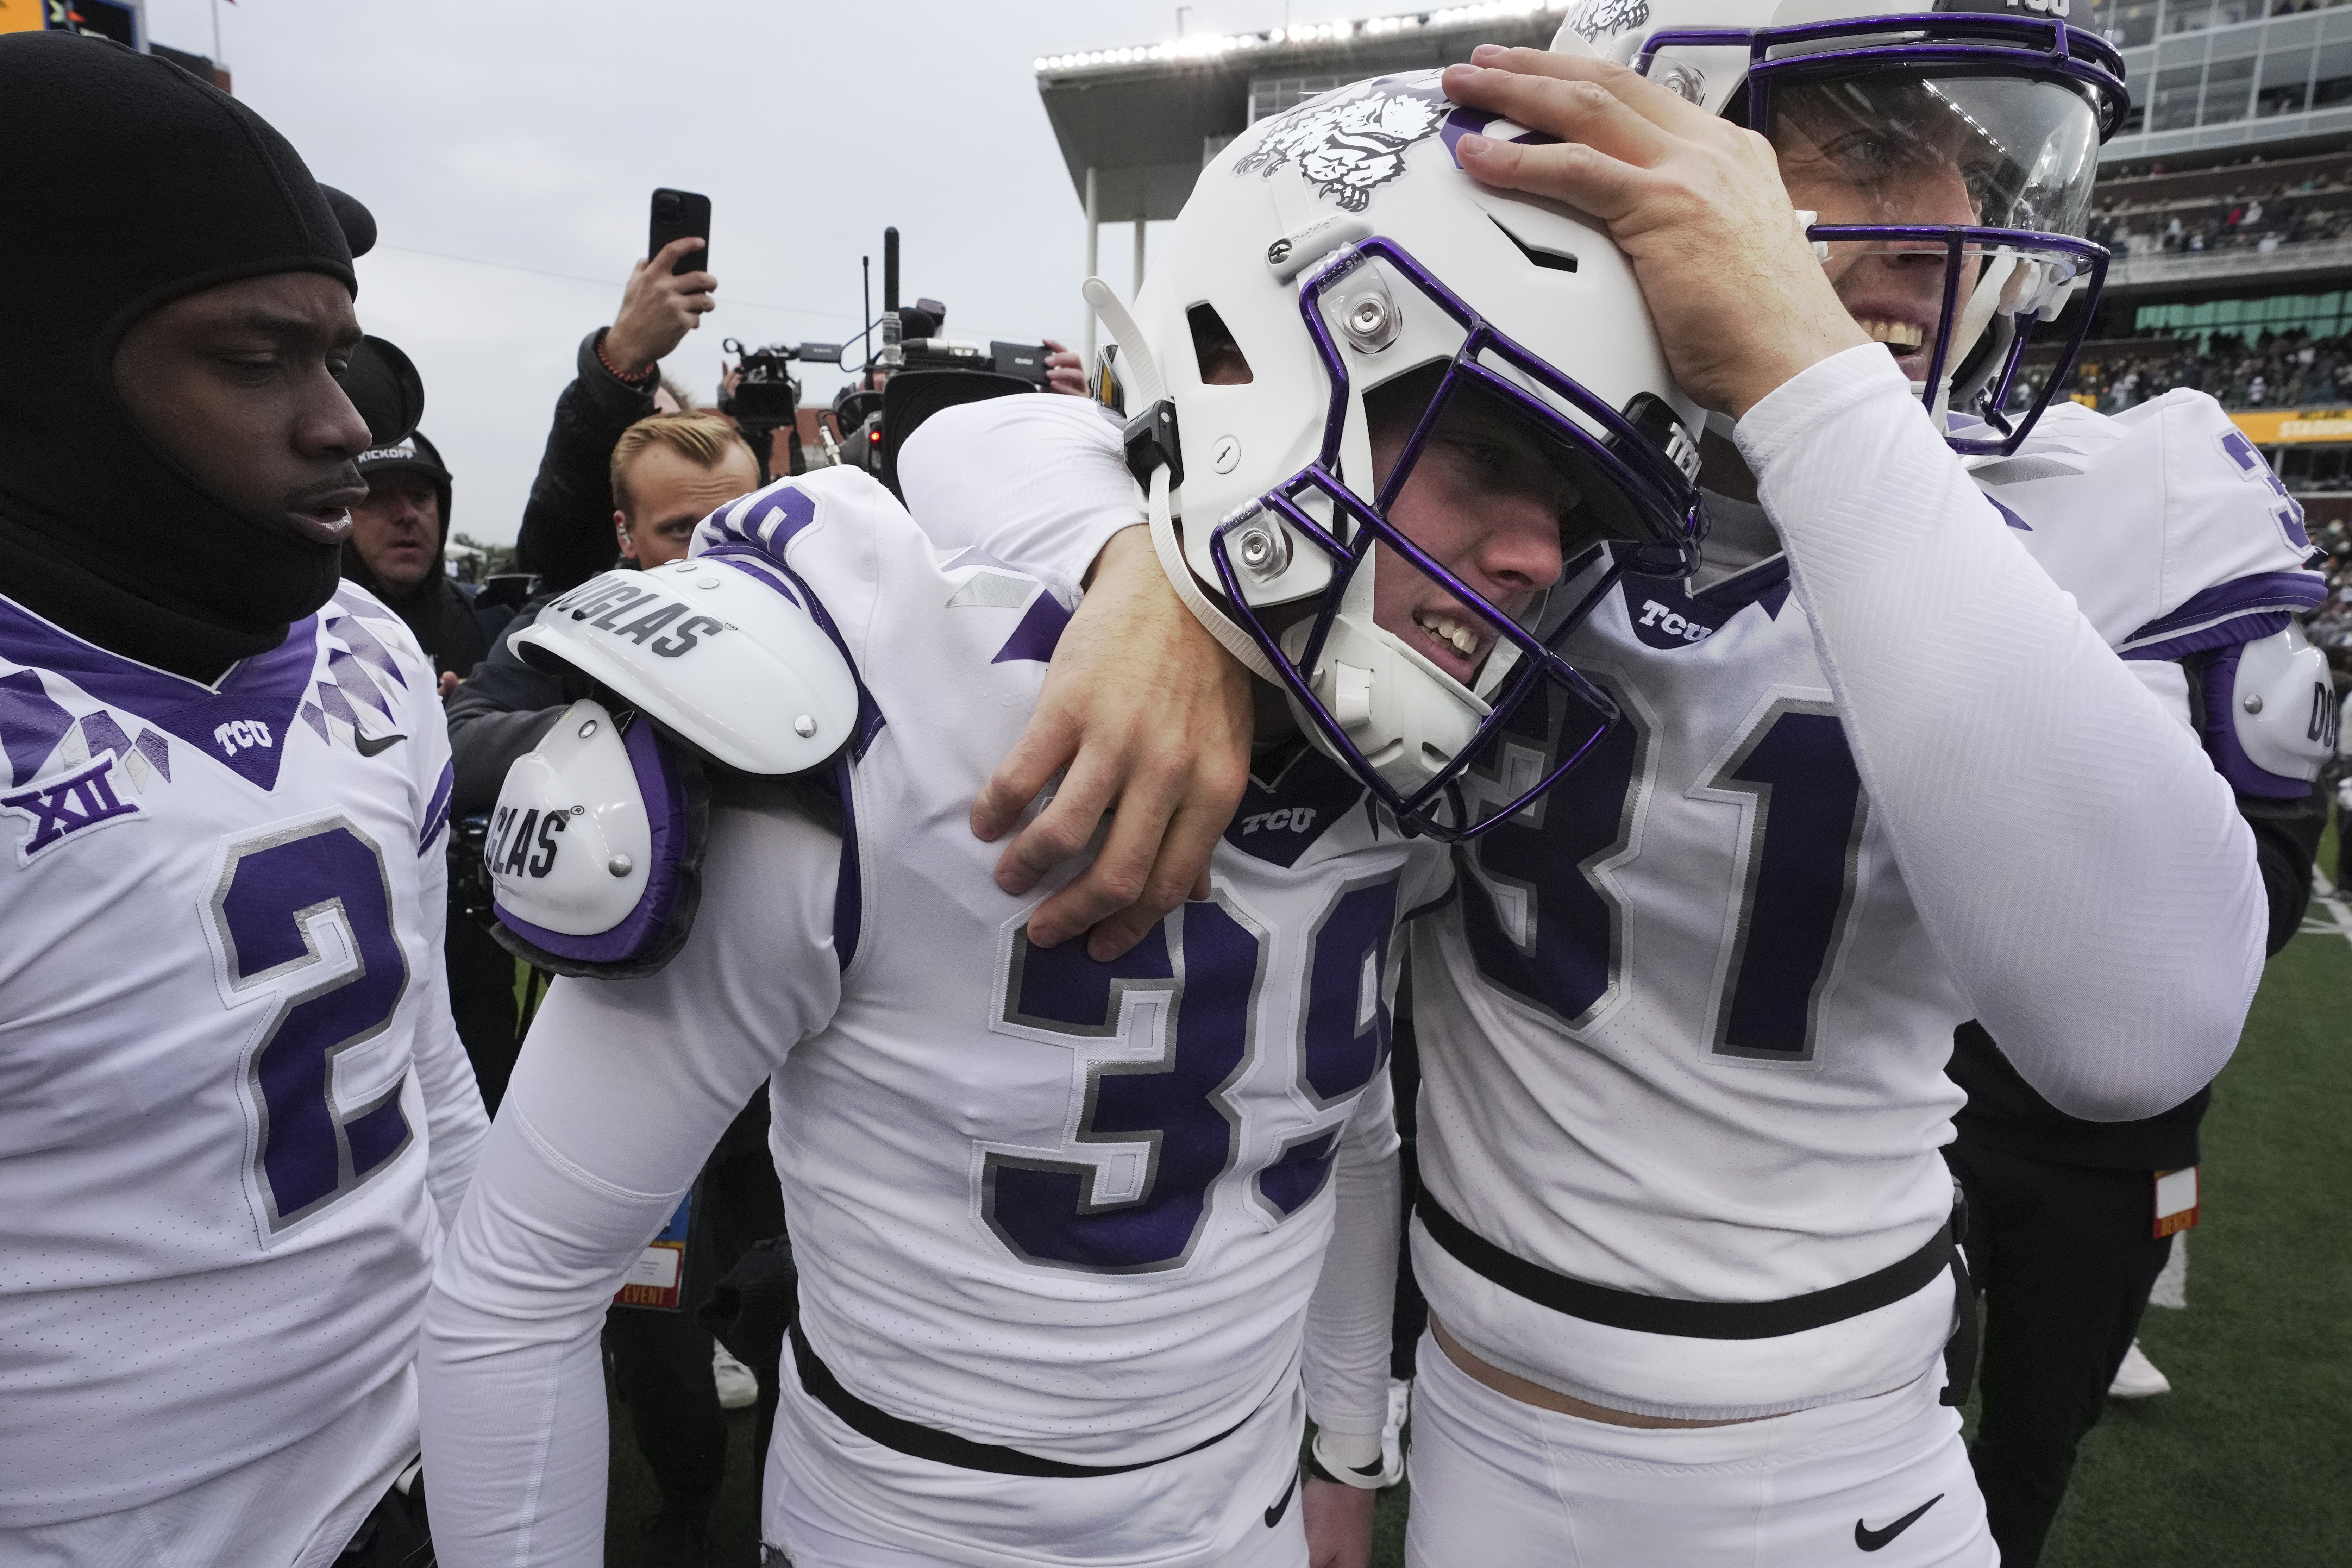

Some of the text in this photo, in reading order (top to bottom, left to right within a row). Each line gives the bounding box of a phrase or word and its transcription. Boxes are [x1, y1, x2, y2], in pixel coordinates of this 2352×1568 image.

[1639, 600, 1712, 641] TCU
[214, 719, 273, 757] TCU
[1242, 807, 1316, 836] TCU
[1456, 663, 1874, 1070] 31
[196, 805, 415, 1250] 2
[969, 875, 1405, 1283] 39
[624, 1284, 664, 1304] EVENT
